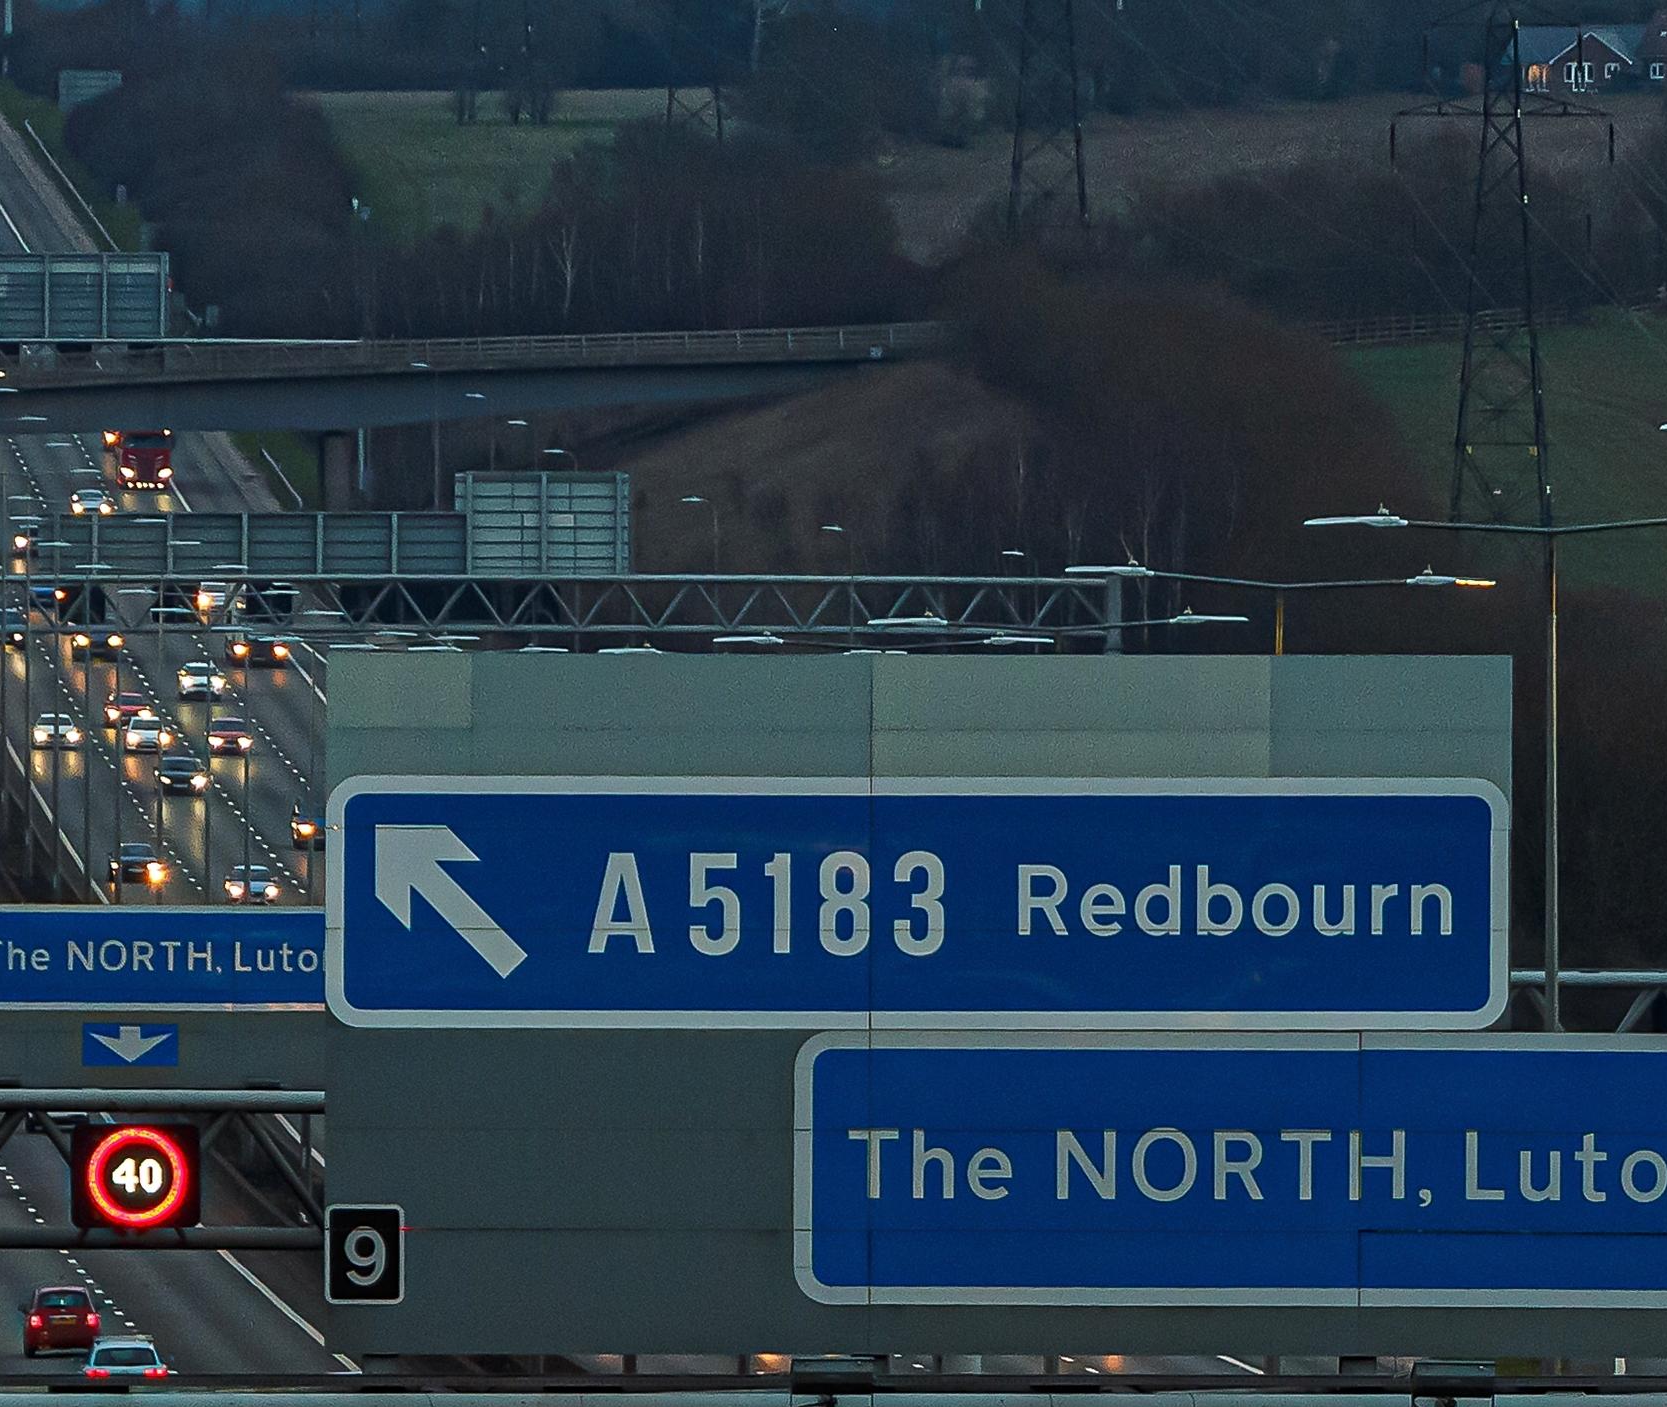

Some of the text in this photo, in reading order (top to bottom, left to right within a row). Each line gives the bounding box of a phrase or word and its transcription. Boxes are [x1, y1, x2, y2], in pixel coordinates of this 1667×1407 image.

[1018, 864, 1453, 937] Redbourn
[67, 940, 222, 974] NORTH,
[235, 941, 326, 973] Luto
[111, 1158, 163, 1193] 40
[849, 1129, 1013, 1200] The
[1056, 1129, 1432, 1208] NORTH,
[344, 1225, 387, 1287] 9
